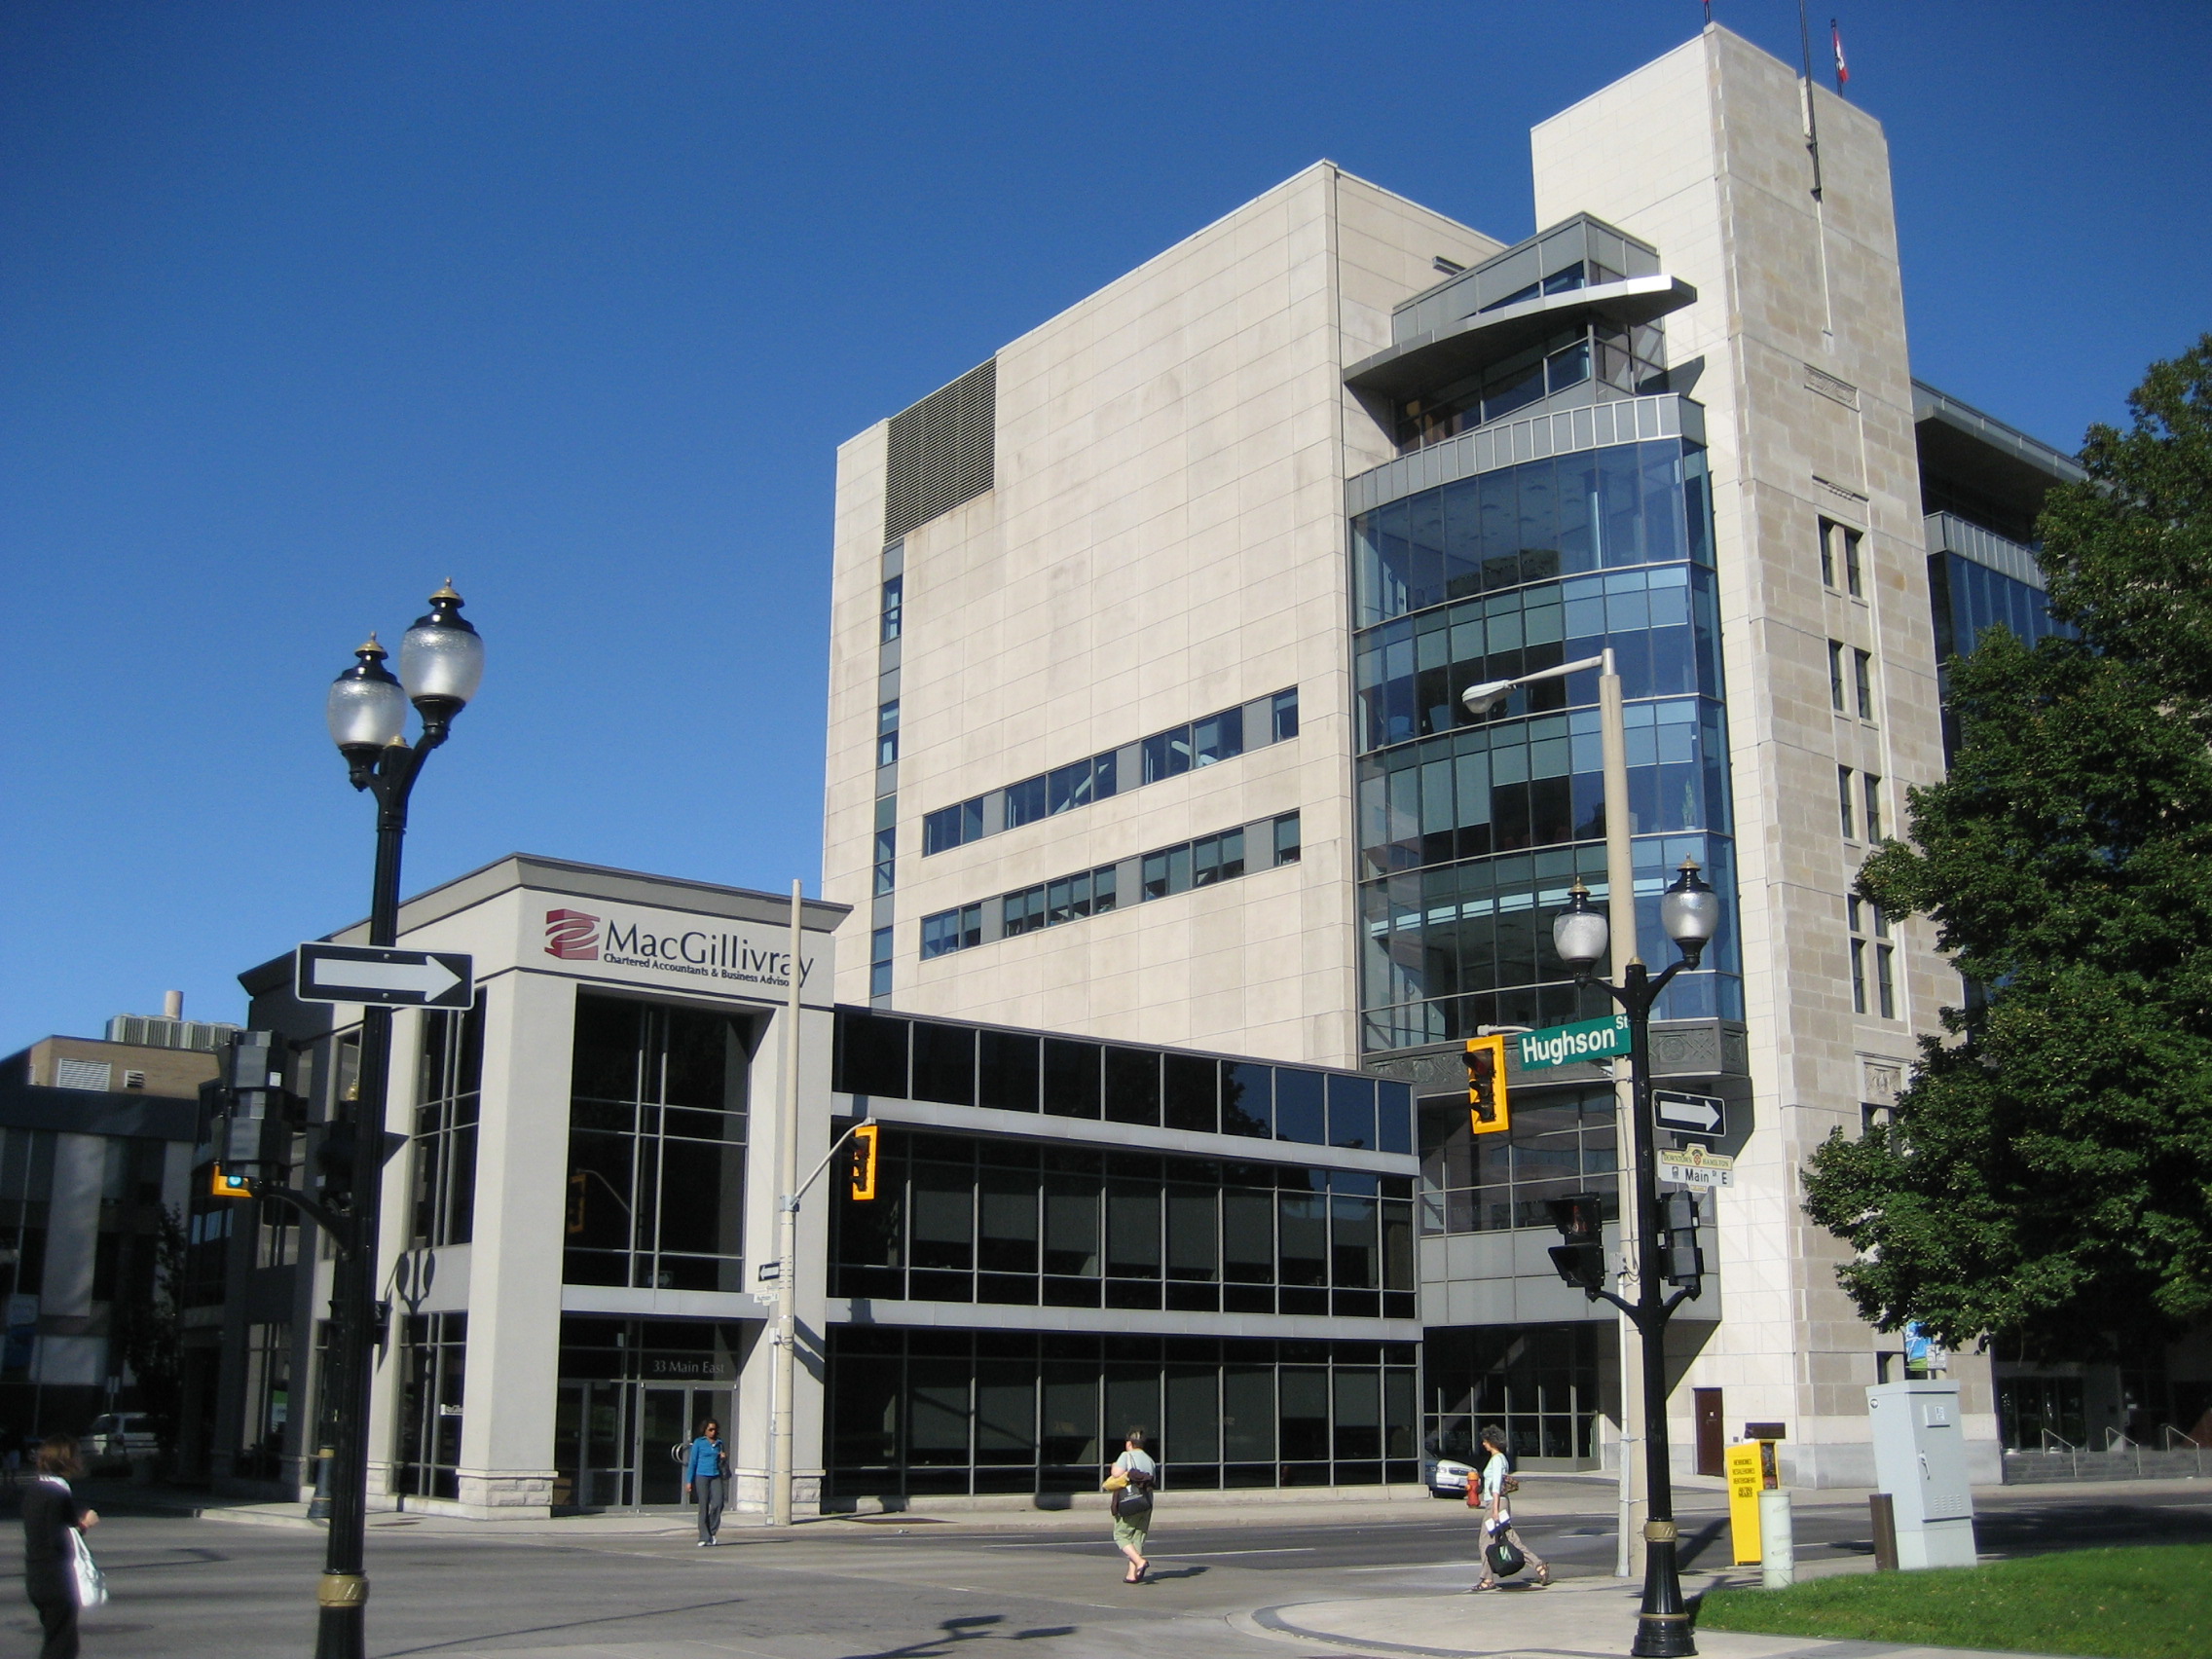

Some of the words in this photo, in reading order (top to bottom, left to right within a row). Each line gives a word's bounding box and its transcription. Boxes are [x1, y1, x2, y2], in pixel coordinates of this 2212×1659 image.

[603, 952, 650, 969] Chartered
[651, 959, 709, 977] Accountants
[711, 967, 719, 978] &
[720, 969, 758, 983] Business
[759, 975, 791, 987] Adviso
[605, 919, 815, 989] MacGillivray
[1522, 1029, 1616, 1066] Hughson
[1615, 1014, 1629, 1030] St
[1684, 1167, 1710, 1184] Main
[1721, 1171, 1728, 1185] E
[653, 1360, 667, 1373] 33
[669, 1360, 699, 1374] Main
[702, 1361, 725, 1374] East
